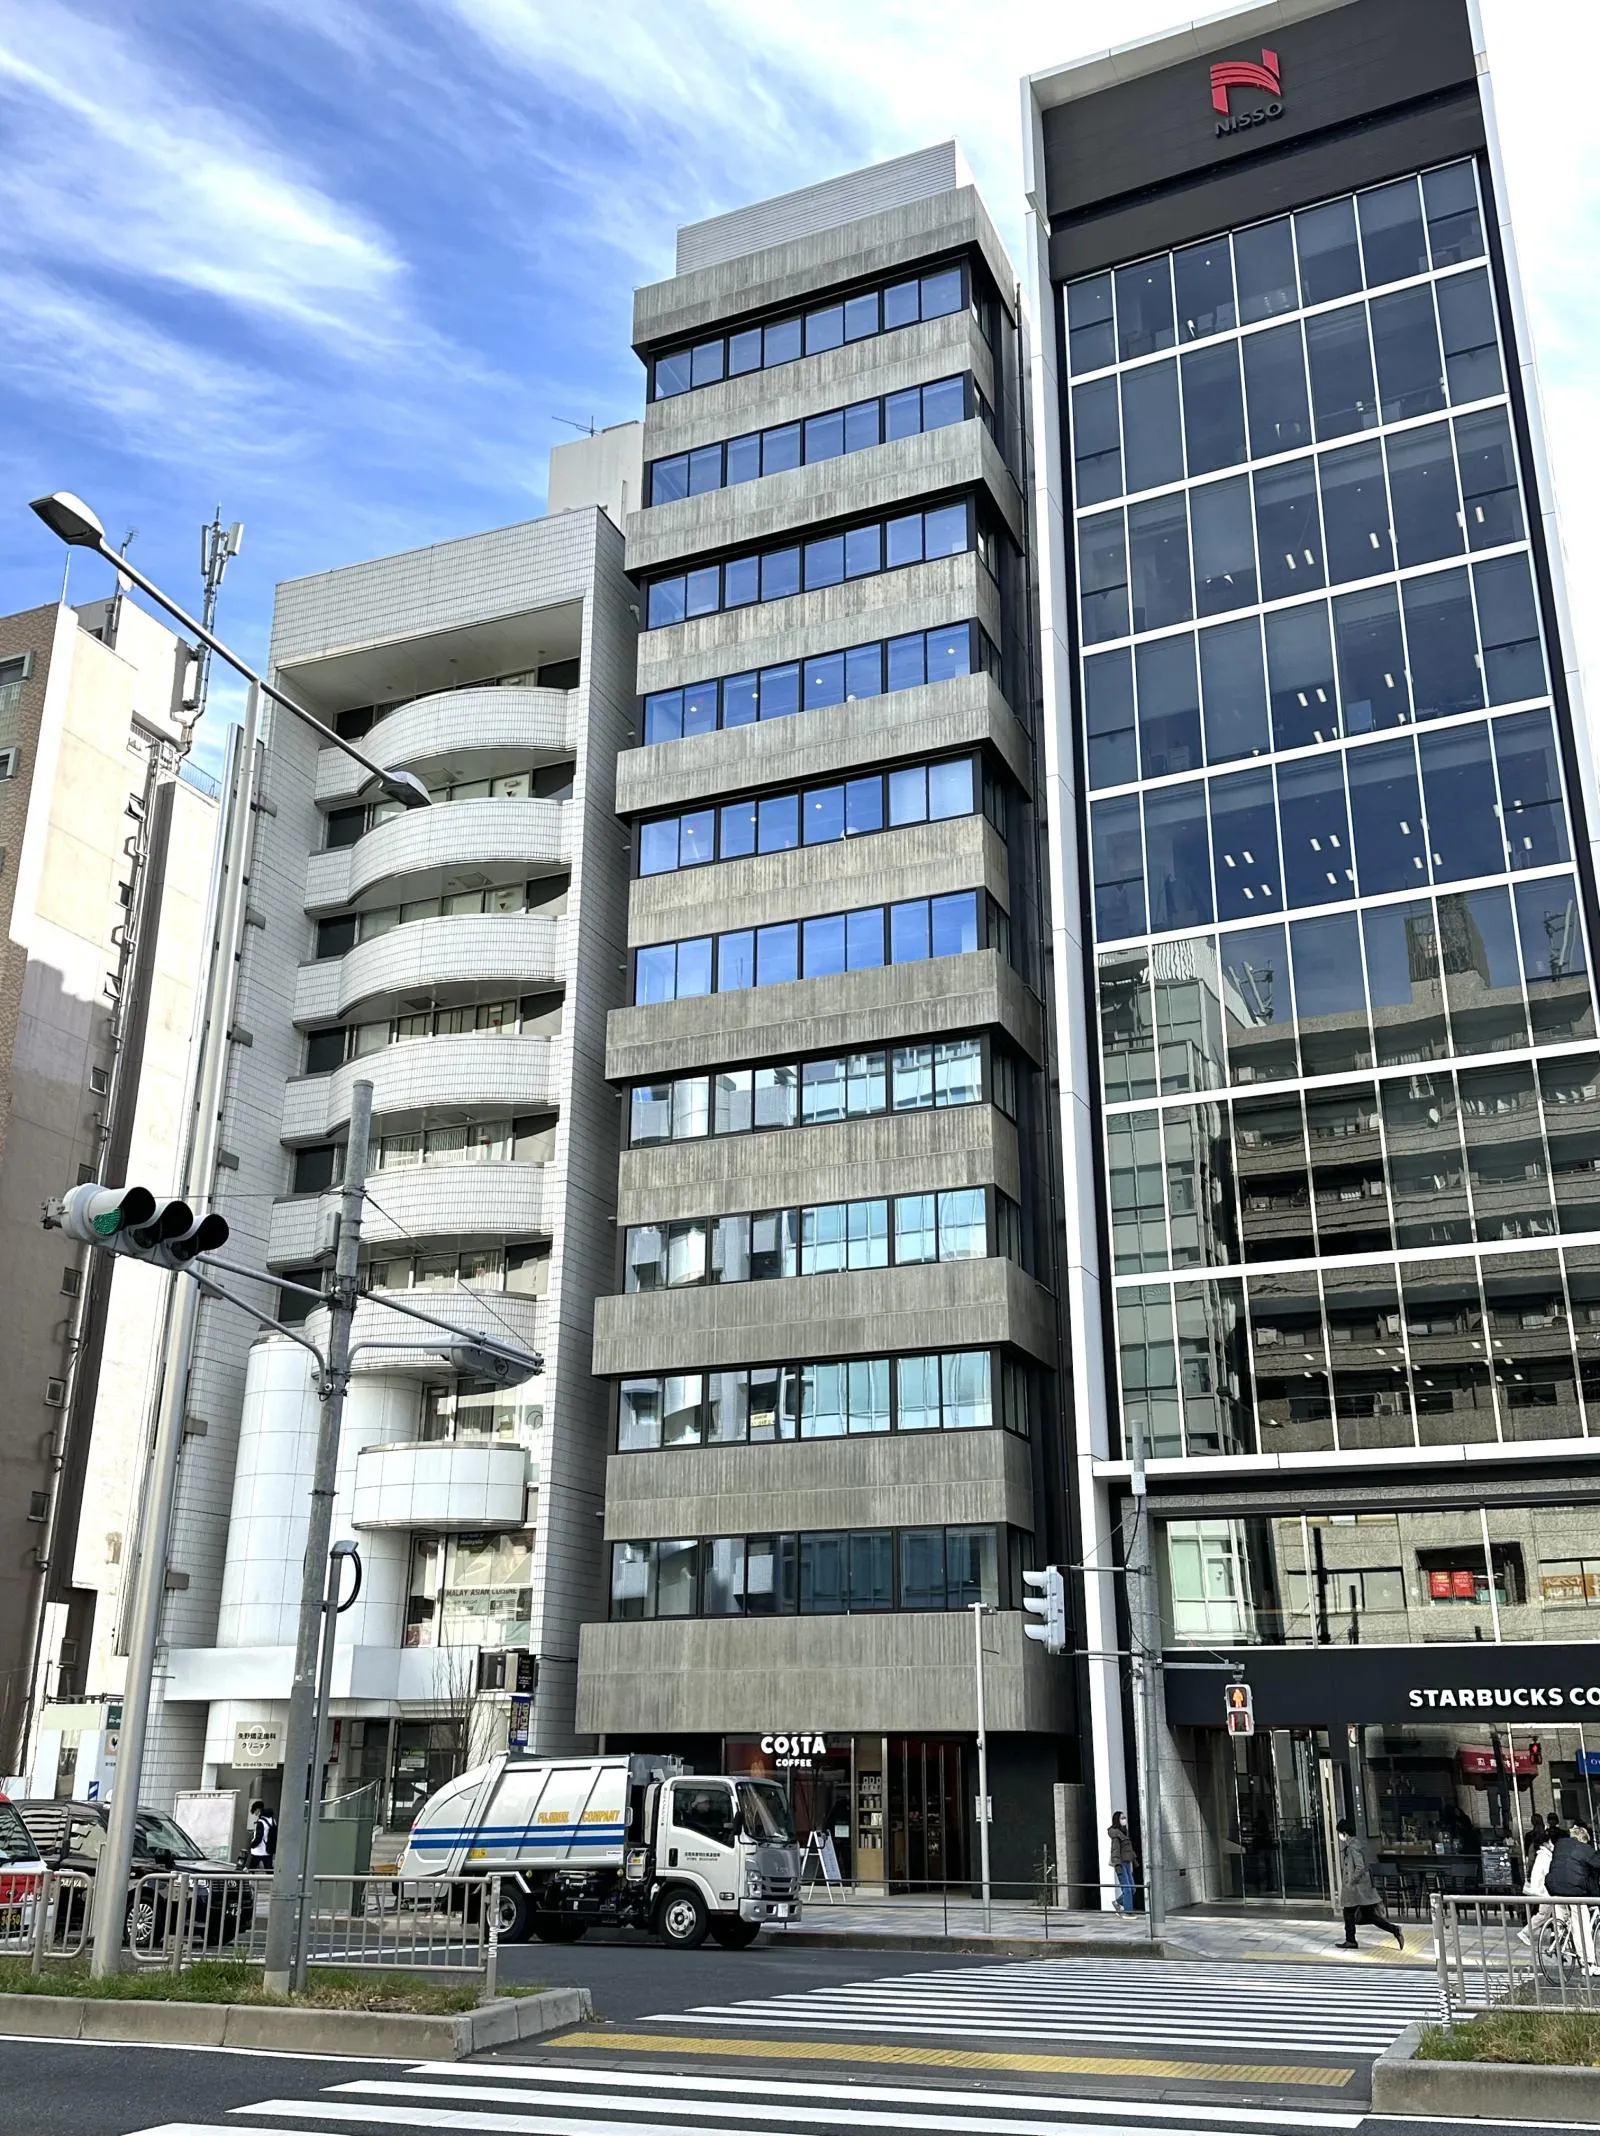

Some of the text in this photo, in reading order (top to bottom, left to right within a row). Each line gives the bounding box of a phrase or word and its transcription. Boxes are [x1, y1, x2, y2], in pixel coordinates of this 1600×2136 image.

[1215, 102, 1283, 136] NISSO
[446, 1589, 467, 1597] MALAY
[470, 1588, 490, 1596] ASIAN
[1408, 1687, 1564, 1707] STARBUCKS
[760, 1736, 826, 1757] COSTA
[775, 1758, 812, 1767] COFFEE
[581, 1809, 620, 1823] COMPANY
